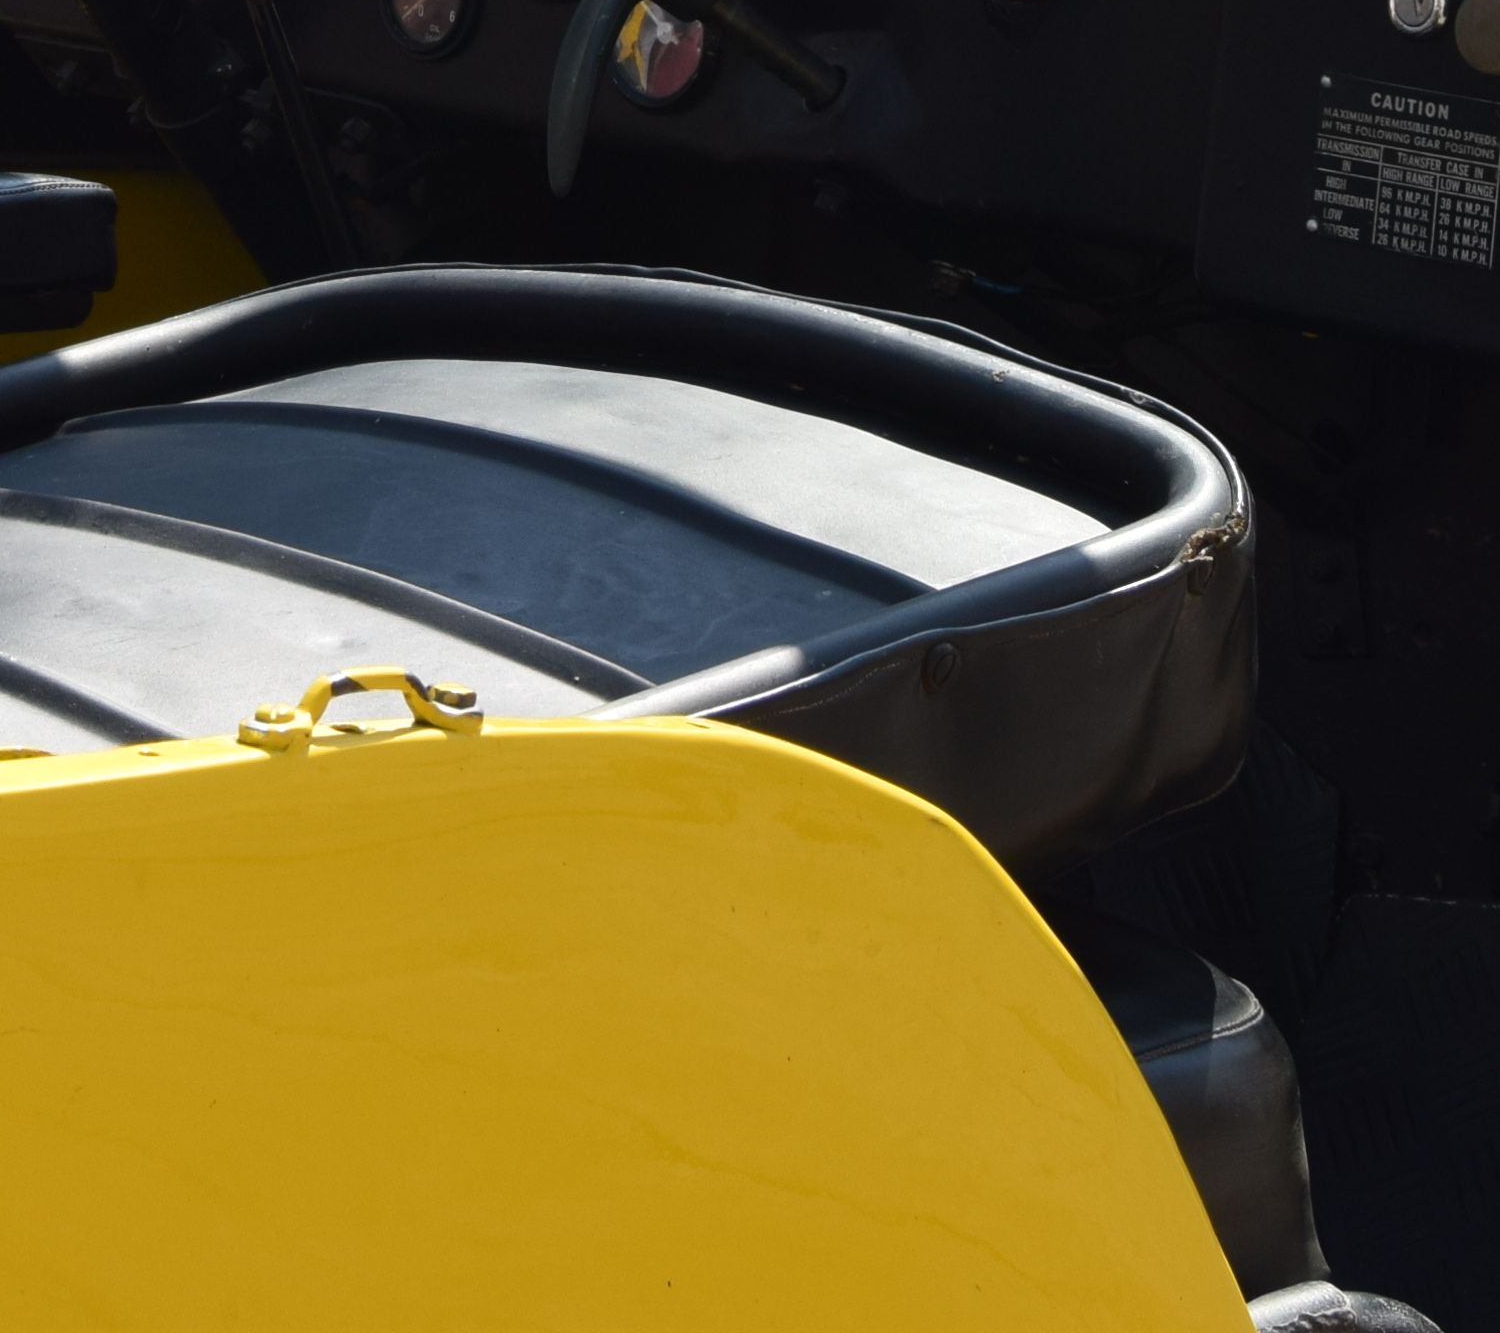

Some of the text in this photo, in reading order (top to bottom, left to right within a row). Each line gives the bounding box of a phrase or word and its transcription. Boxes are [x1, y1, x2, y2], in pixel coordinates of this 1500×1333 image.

[1370, 92, 1449, 120] CAUTION
[1323, 107, 1373, 124] MAXIMUM
[1374, 116, 1431, 134] PERMISSIBLE
[1432, 125, 1462, 140] ROAD
[1317, 138, 1380, 160] TRANSMISSION
[1321, 120, 1495, 160] IN THE FOLLOWING GEAR POSITIONS
[1341, 159, 1352, 172] IN
[1383, 167, 1434, 188] HIGH RANGE
[1397, 152, 1484, 179] TRANSFER CASE IN
[1325, 175, 1452, 211] HIGH 96 38
[1440, 177, 1494, 199] LOW RANGE
[1313, 189, 1376, 212] INTERMEDIATE
[1379, 201, 1391, 215] 64
[1322, 207, 1448, 242] LOW 34 14
[1321, 222, 1360, 241] EVERSE
[1437, 244, 1447, 257] 10
